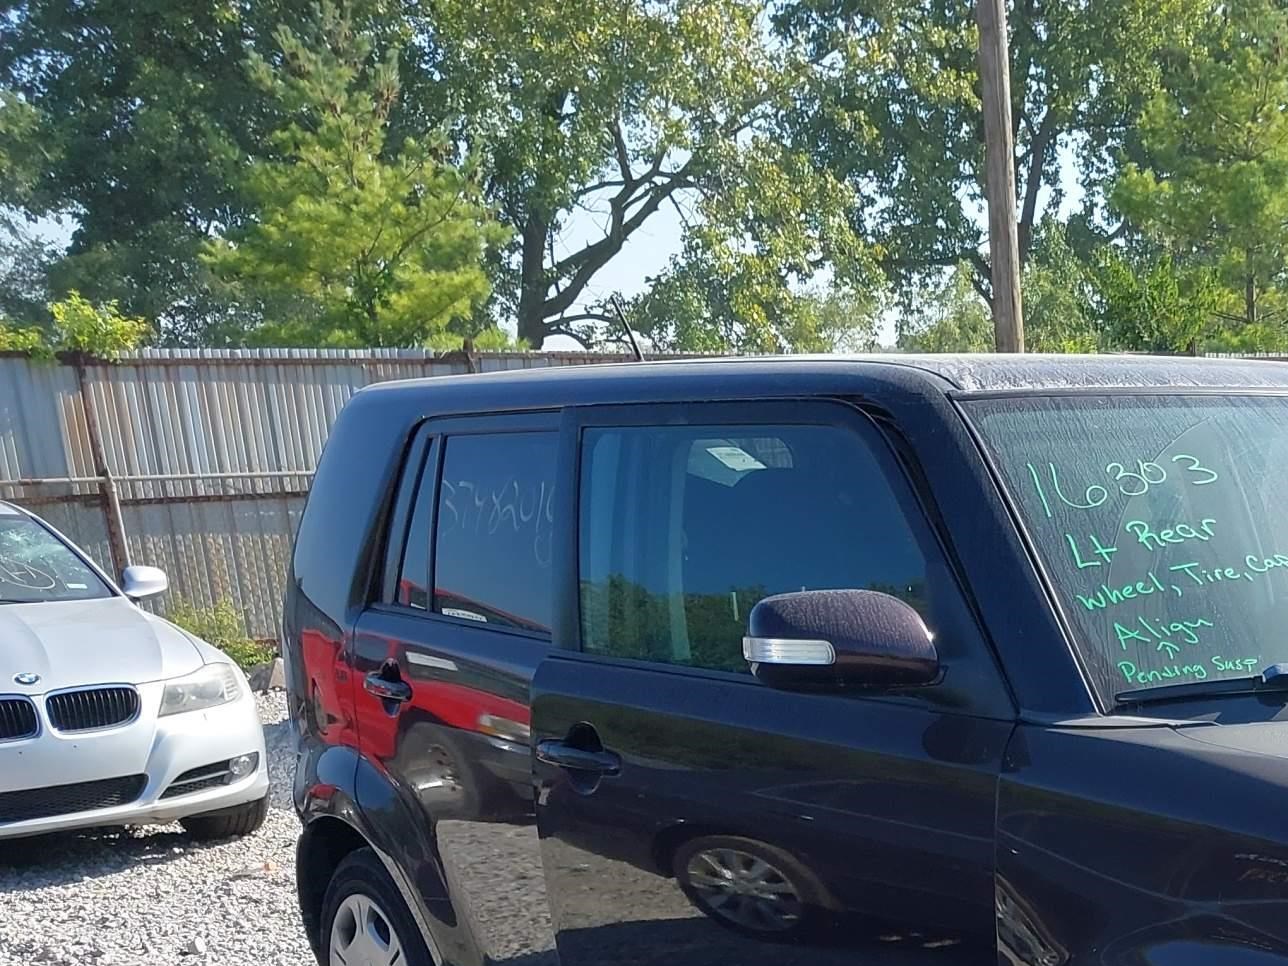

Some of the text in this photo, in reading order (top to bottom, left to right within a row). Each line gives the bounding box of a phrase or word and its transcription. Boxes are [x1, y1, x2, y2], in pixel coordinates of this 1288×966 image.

[1027, 454, 1218, 518] 16303
[1065, 517, 1217, 570] Lt Rear
[1113, 616, 1214, 651] Align
[1117, 660, 1207, 684] Pending
